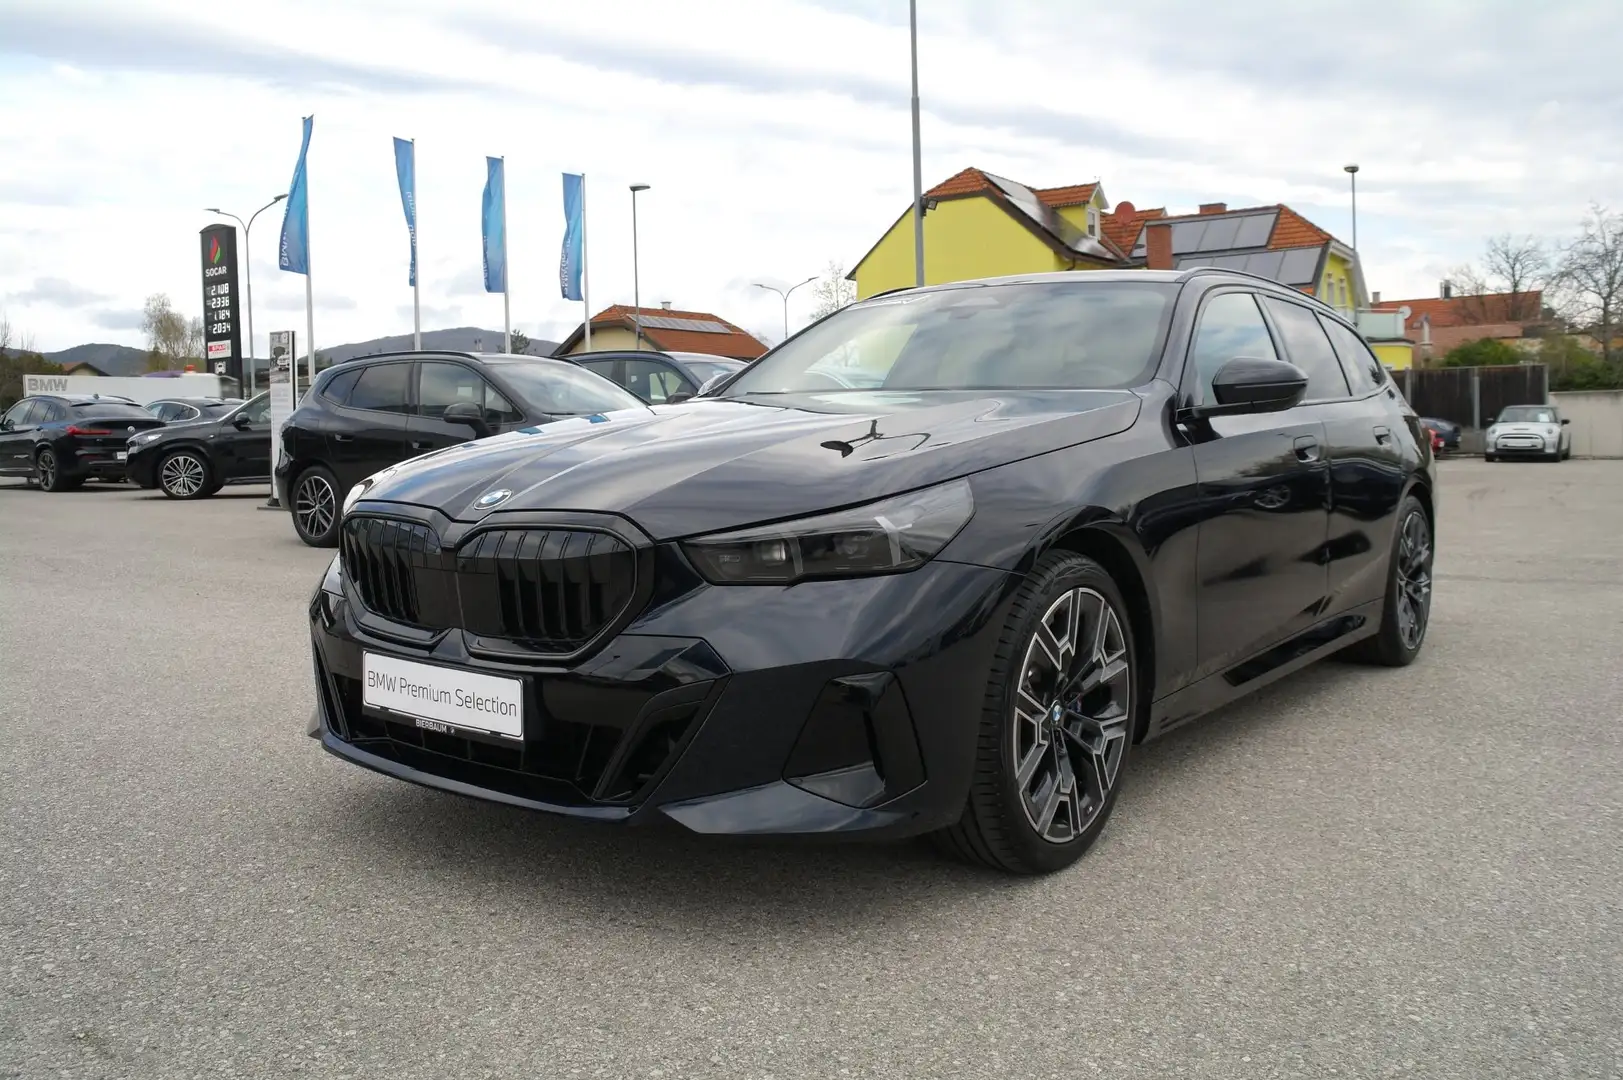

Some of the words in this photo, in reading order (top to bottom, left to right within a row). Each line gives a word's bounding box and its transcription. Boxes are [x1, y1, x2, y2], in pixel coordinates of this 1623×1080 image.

[205, 266, 227, 278] SOCAR
[27, 378, 68, 392] BMW
[368, 670, 397, 693] BMW
[399, 676, 452, 705] Premium
[455, 688, 517, 717] Selection
[415, 718, 447, 734] BIERBAUM
